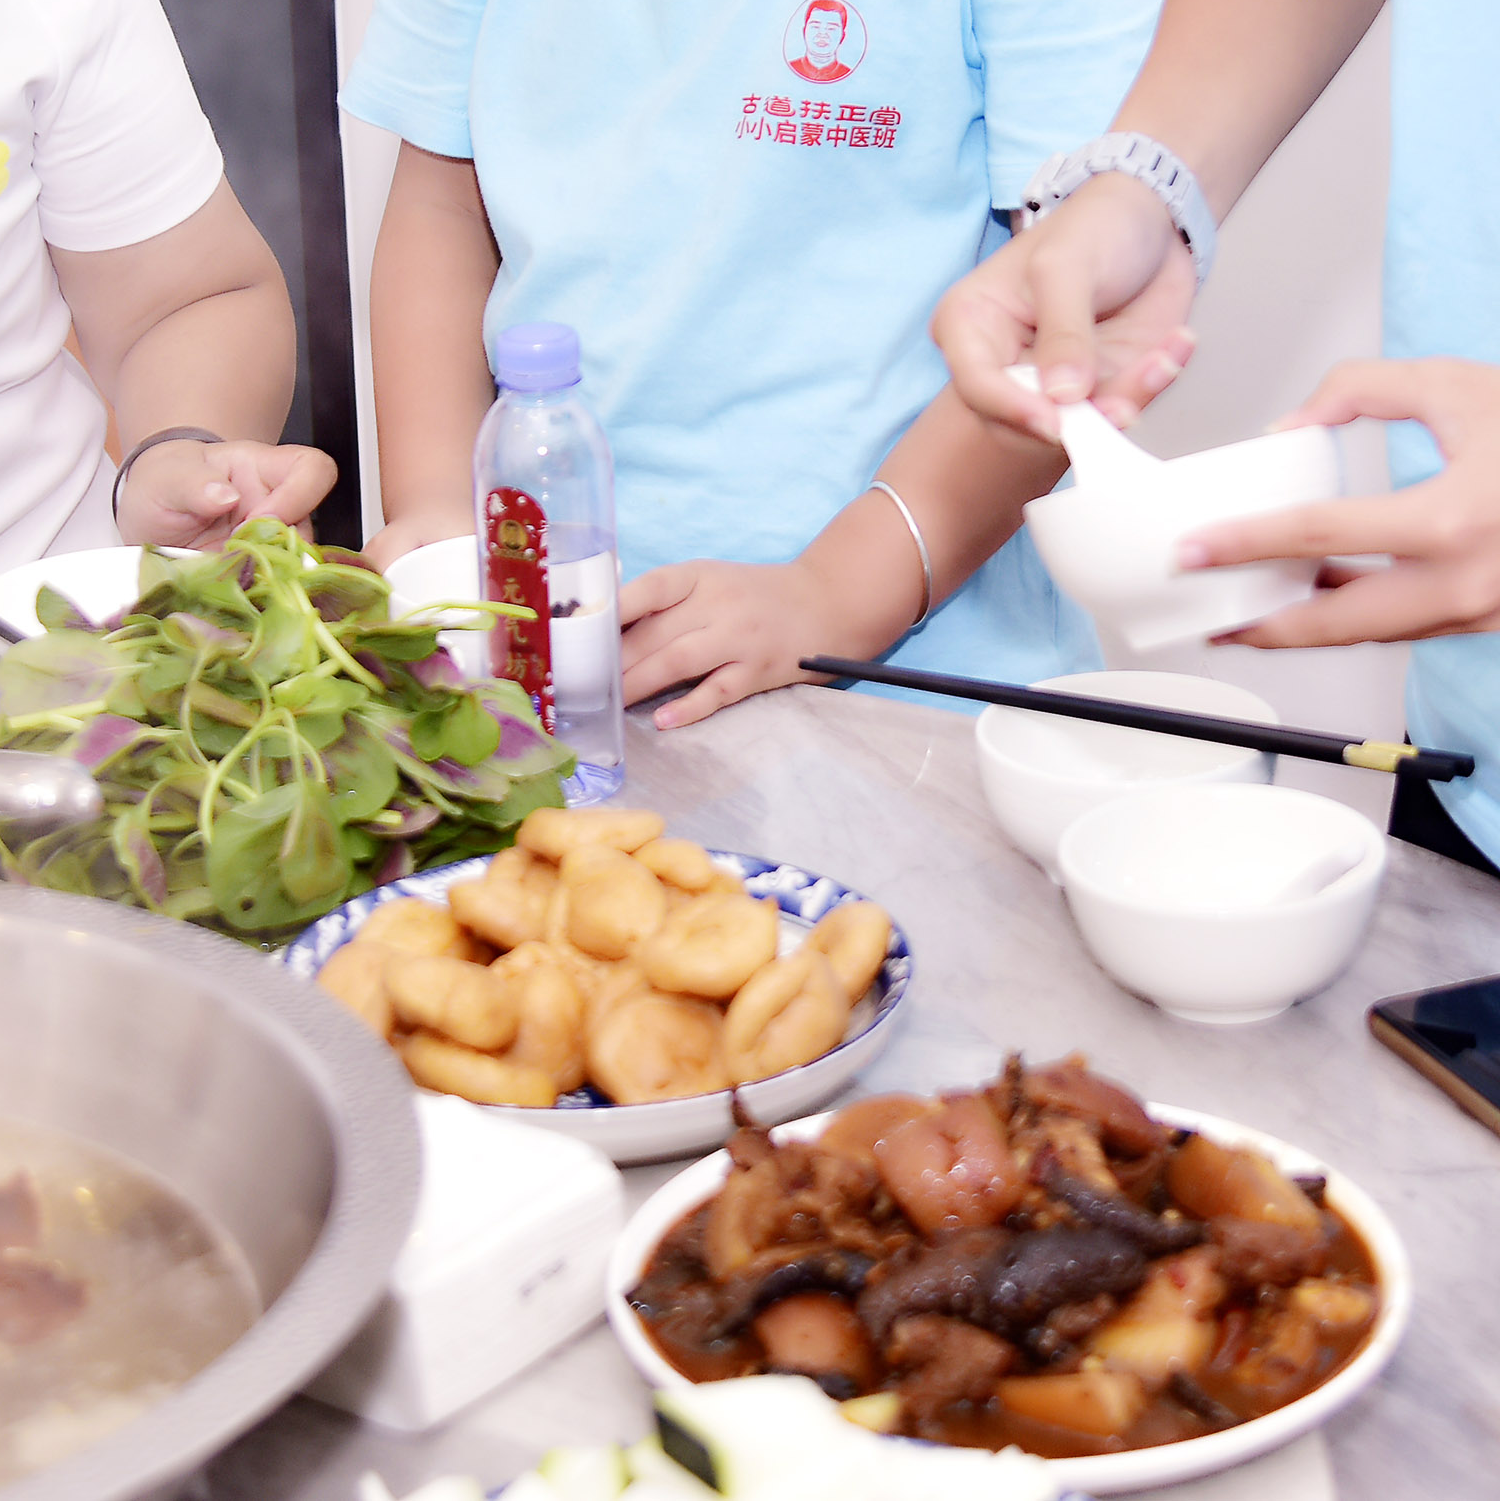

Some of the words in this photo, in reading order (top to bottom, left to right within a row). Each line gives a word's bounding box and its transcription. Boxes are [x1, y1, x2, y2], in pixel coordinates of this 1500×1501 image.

[742, 93, 901, 125] 古道扶正堂
[735, 116, 896, 148] 小小启蒙中医班
